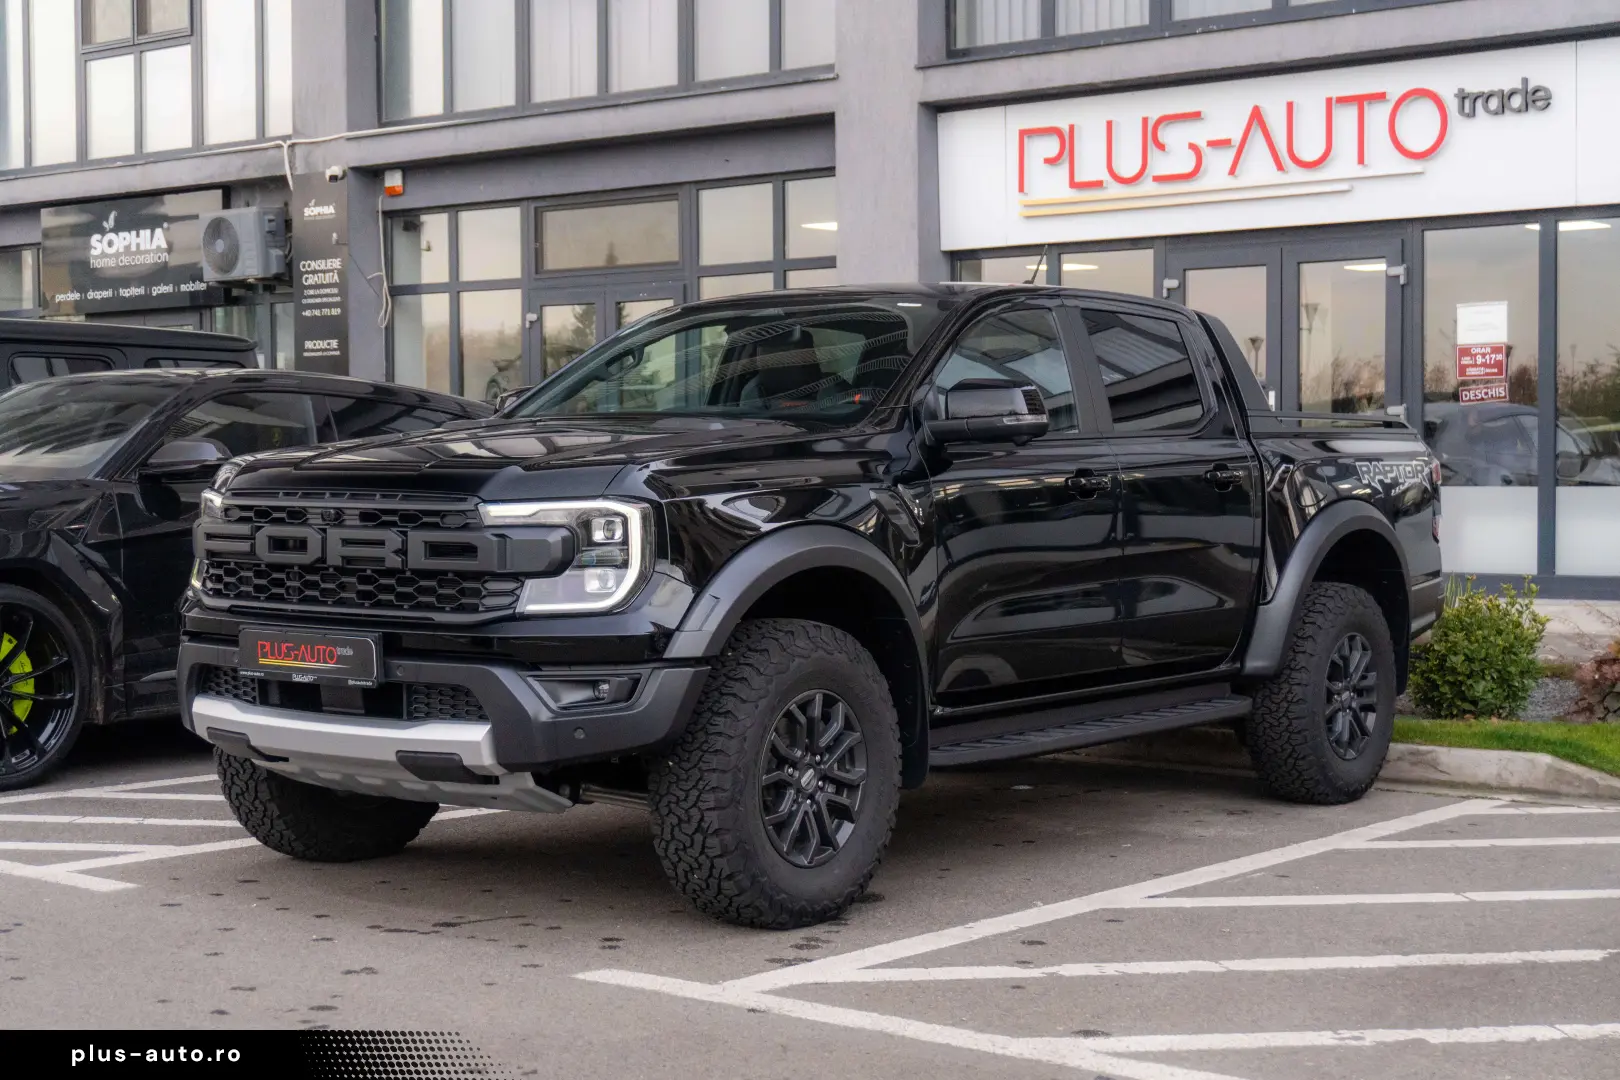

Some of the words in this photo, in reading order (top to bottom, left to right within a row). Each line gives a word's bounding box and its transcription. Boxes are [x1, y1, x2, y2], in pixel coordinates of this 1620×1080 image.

[1018, 87, 1450, 194] PLUS-AUTO
[1455, 77, 1553, 118] trade
[90, 228, 169, 256] SOPHIA
[90, 256, 117, 269] home
[118, 252, 169, 267] decoration
[300, 258, 342, 272] CONSILIERE
[302, 270, 340, 286] GRATUITĂ
[55, 290, 81, 303] perdele
[87, 289, 113, 300] draperii
[151, 283, 174, 297] galerii
[180, 280, 207, 292] mobilier
[1462, 387, 1506, 401] DESCHIS
[1355, 461, 1432, 492] RAPTOR
[194, 523, 503, 573] FORD
[257, 640, 337, 664] PLUS-AUTO
